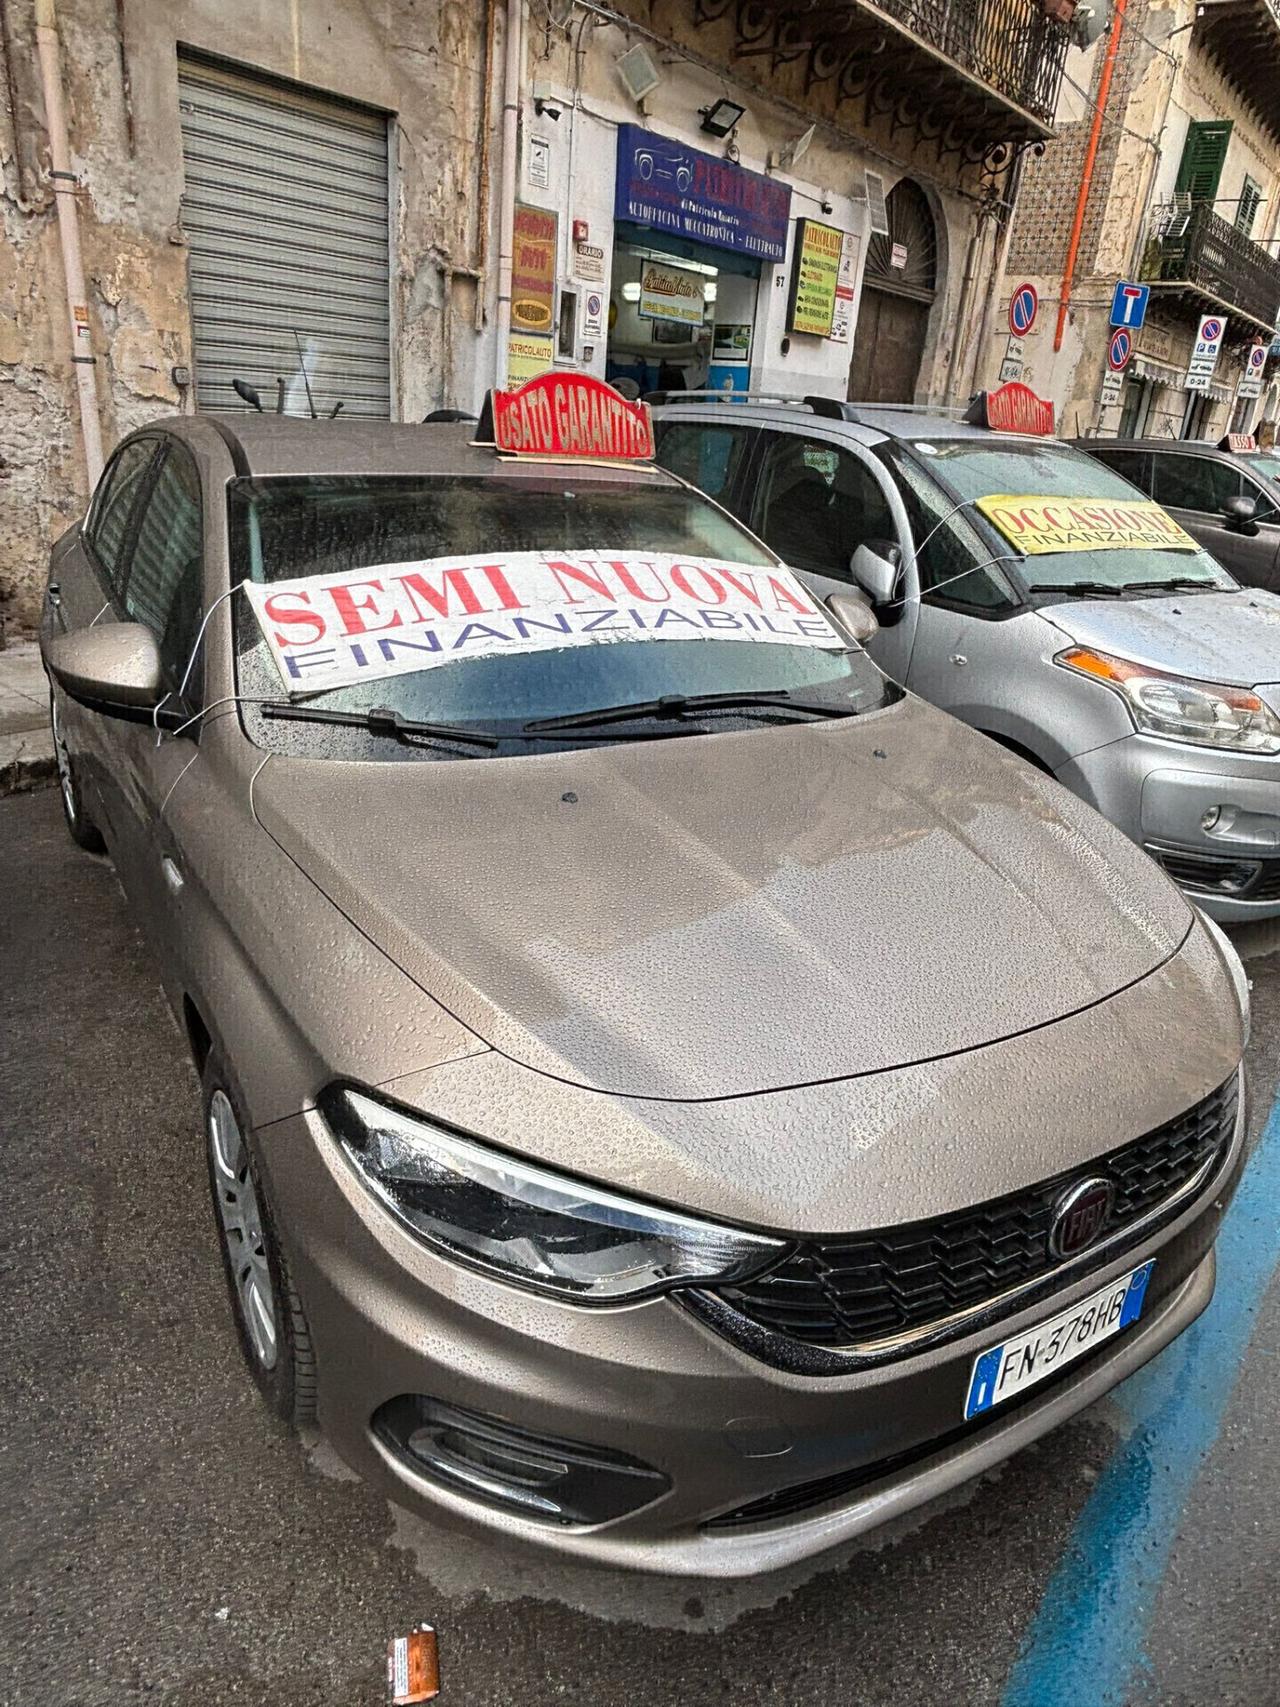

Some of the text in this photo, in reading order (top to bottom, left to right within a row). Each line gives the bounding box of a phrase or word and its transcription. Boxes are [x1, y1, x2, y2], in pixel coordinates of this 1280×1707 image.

[629, 201, 680, 229] AUTOFFICINA
[500, 383, 648, 454] USATO GARANTITO
[992, 506, 1182, 534] OCCASIONE
[1015, 531, 1194, 545] FINANZIABILE
[264, 560, 818, 648] SEMI NUOVA
[283, 608, 836, 678] FINANZIABILE
